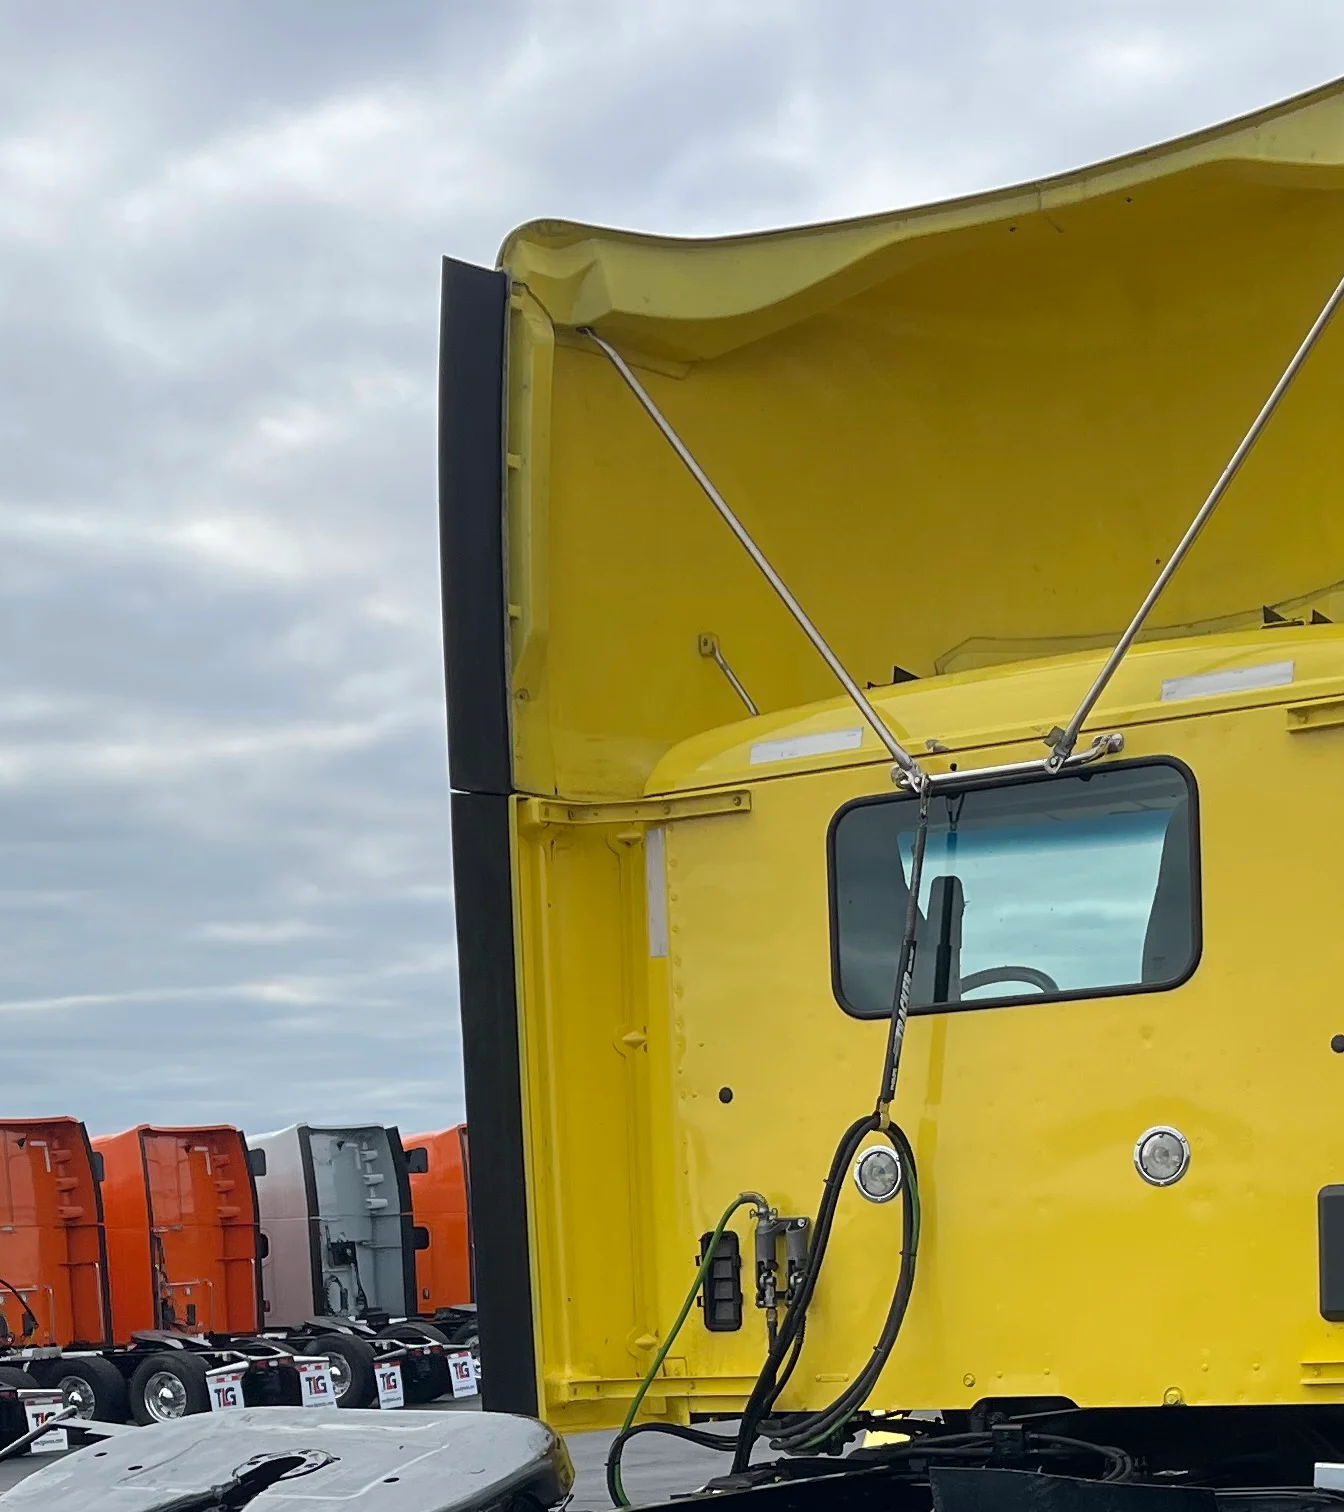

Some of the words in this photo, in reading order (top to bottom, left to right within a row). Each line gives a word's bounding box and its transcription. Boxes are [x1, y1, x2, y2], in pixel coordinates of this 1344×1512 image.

[453, 1361, 470, 1379] TLG
[305, 1375, 327, 1395] TLG
[379, 1372, 397, 1392] TLG
[214, 1387, 237, 1408] TLG
